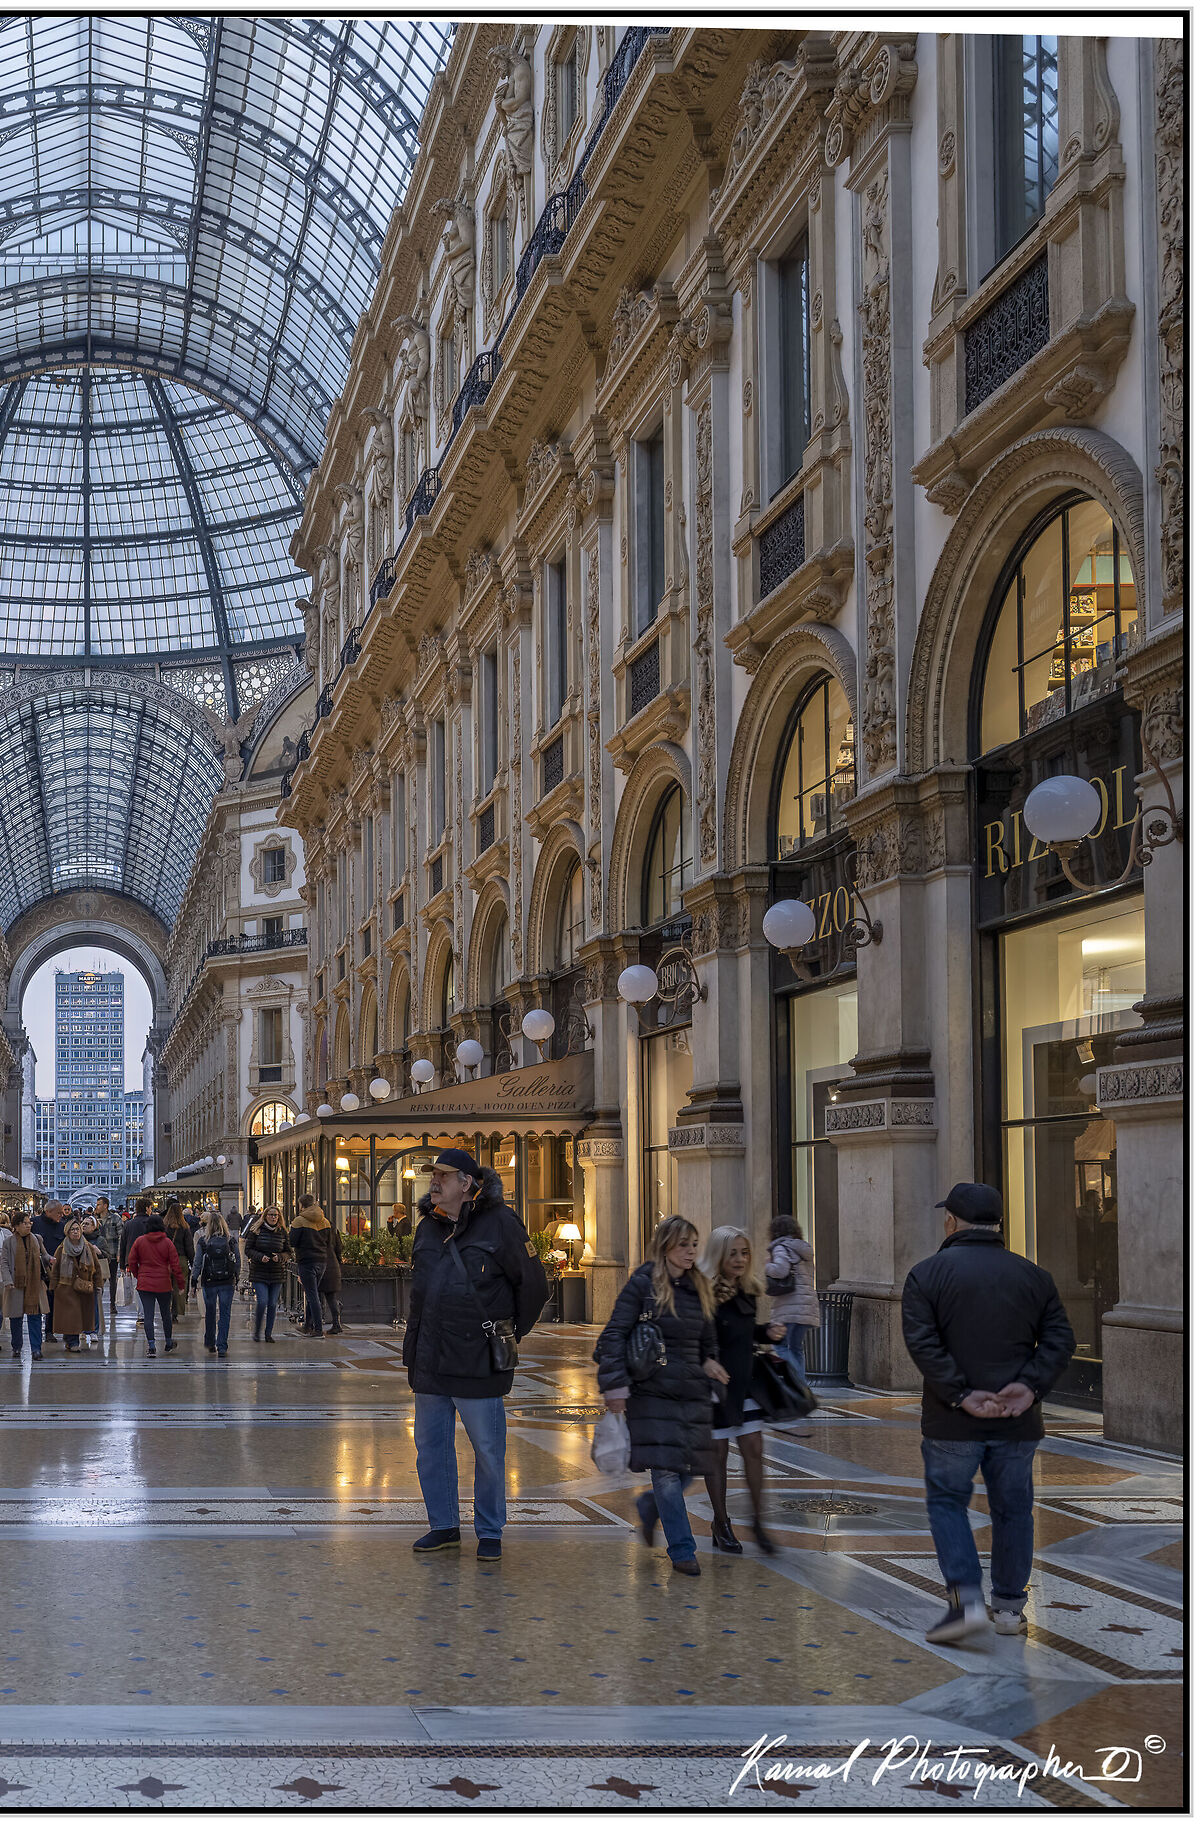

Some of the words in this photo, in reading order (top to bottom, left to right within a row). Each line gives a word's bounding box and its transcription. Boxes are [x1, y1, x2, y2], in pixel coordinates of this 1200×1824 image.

[497, 1075, 576, 1098] Galleria
[410, 1103, 474, 1112] RESTAURANT
[483, 1102, 515, 1111] WOOD
[516, 1102, 548, 1110] OVEN
[547, 1101, 577, 1110] PIZZA
